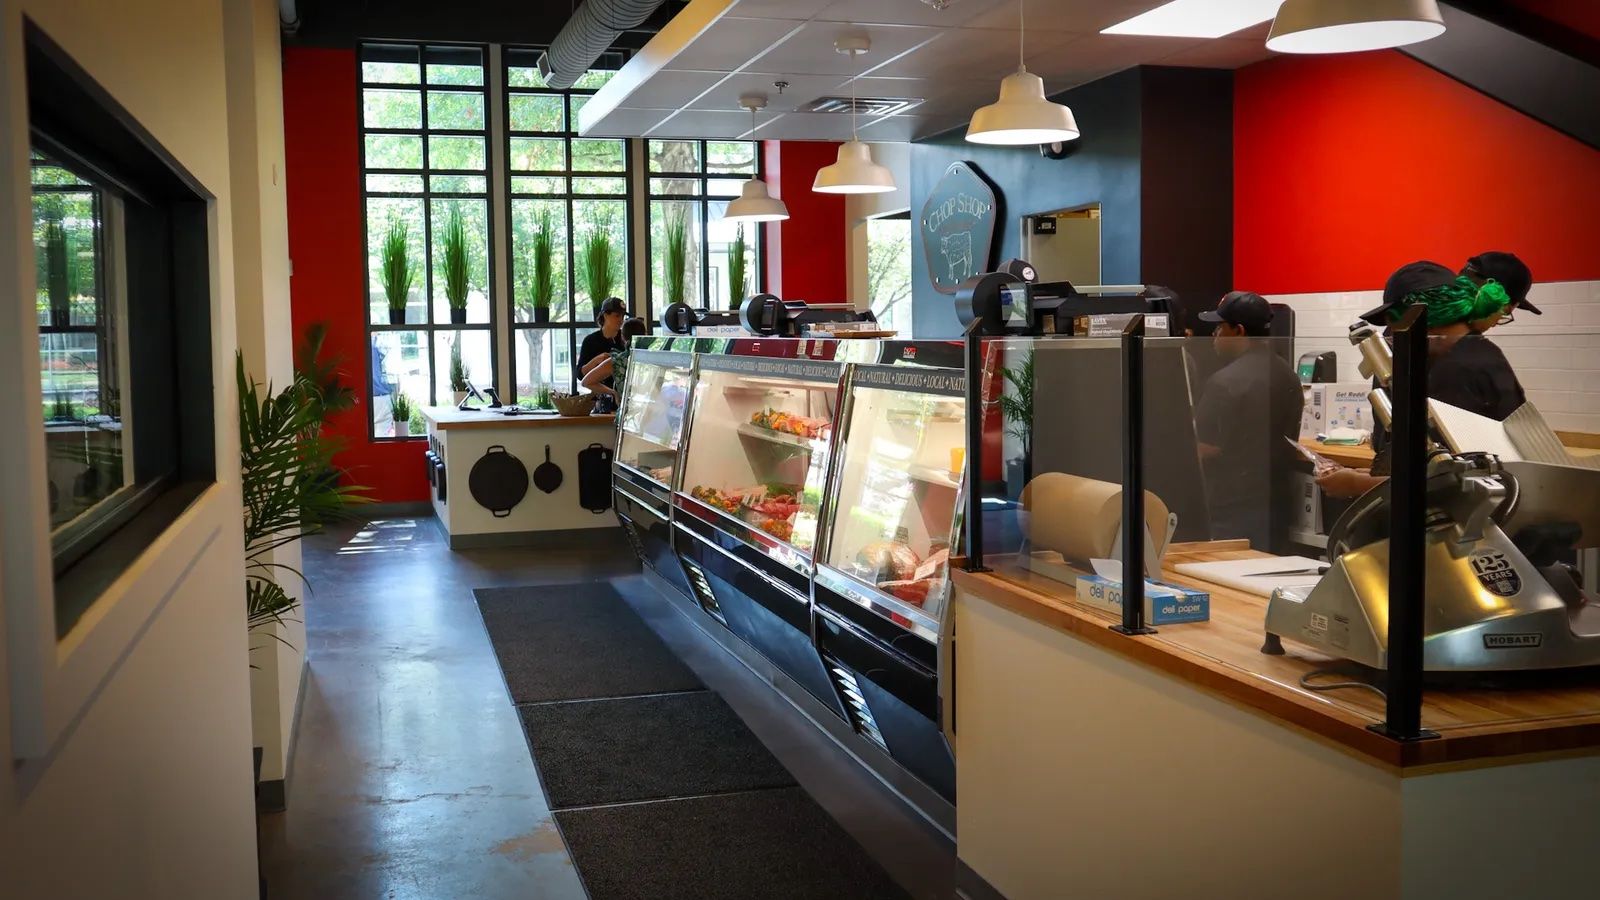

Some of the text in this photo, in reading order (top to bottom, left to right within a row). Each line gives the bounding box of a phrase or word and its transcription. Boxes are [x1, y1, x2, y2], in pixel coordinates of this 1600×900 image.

[929, 192, 987, 232] CHOP SHOP
[720, 326, 740, 334] paper
[869, 371, 892, 384] NATURAL
[894, 372, 923, 388] DELICIOUS
[926, 375, 945, 389] LOCAL
[1472, 553, 1510, 574] 125
[1482, 570, 1513, 581] YEARS
[1089, 583, 1105, 599] deli
[1162, 604, 1201, 614] deli paper
[1489, 636, 1537, 645] HOBART
